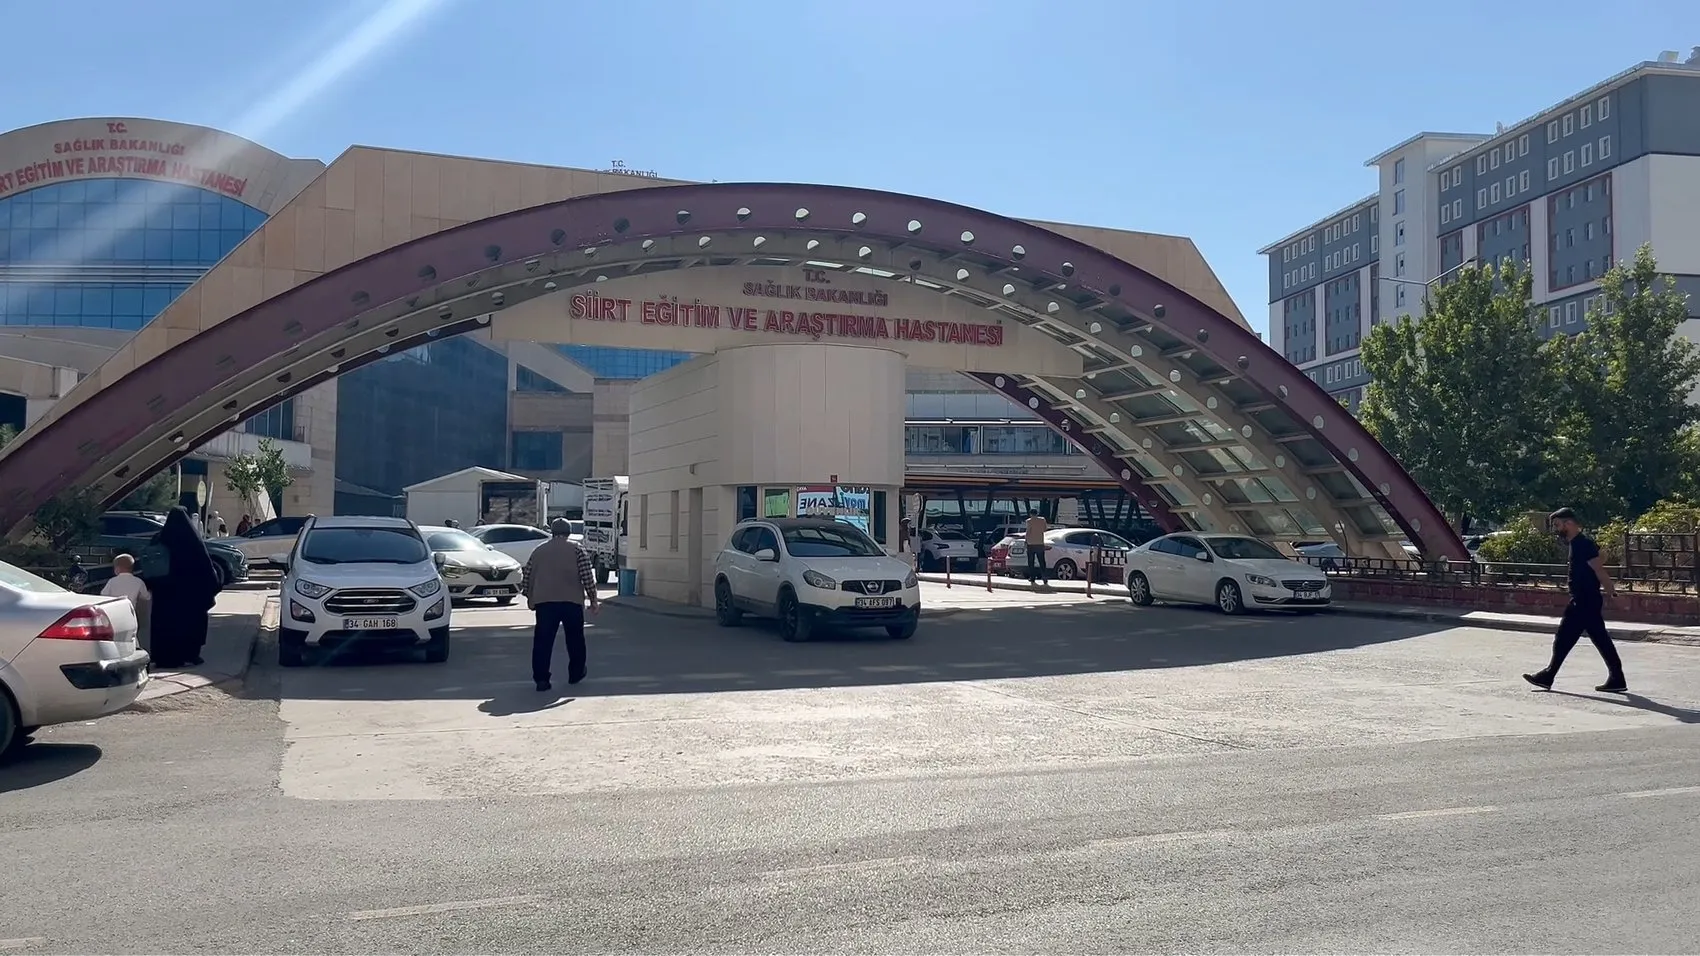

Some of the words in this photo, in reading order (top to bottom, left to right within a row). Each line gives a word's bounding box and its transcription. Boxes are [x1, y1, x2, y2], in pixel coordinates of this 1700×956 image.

[106, 122, 127, 134] T.C.
[65, 158, 84, 175] VE
[88, 155, 166, 177] ARAŞTIRMA
[611, 159, 626, 168] T.C.
[803, 268, 830, 284] T.C.
[743, 279, 802, 299] SAĞLIK
[805, 286, 888, 306] BAKANLIĞI
[569, 289, 632, 321] SİİRT
[641, 294, 720, 328] EĞİTİM
[727, 306, 758, 331] VE
[764, 309, 889, 341] ARAŞTIRMA
[894, 318, 1003, 346] HASTANESİ
[349, 619, 359, 629] 34
[363, 619, 379, 629] GAH
[382, 618, 396, 628] 168
